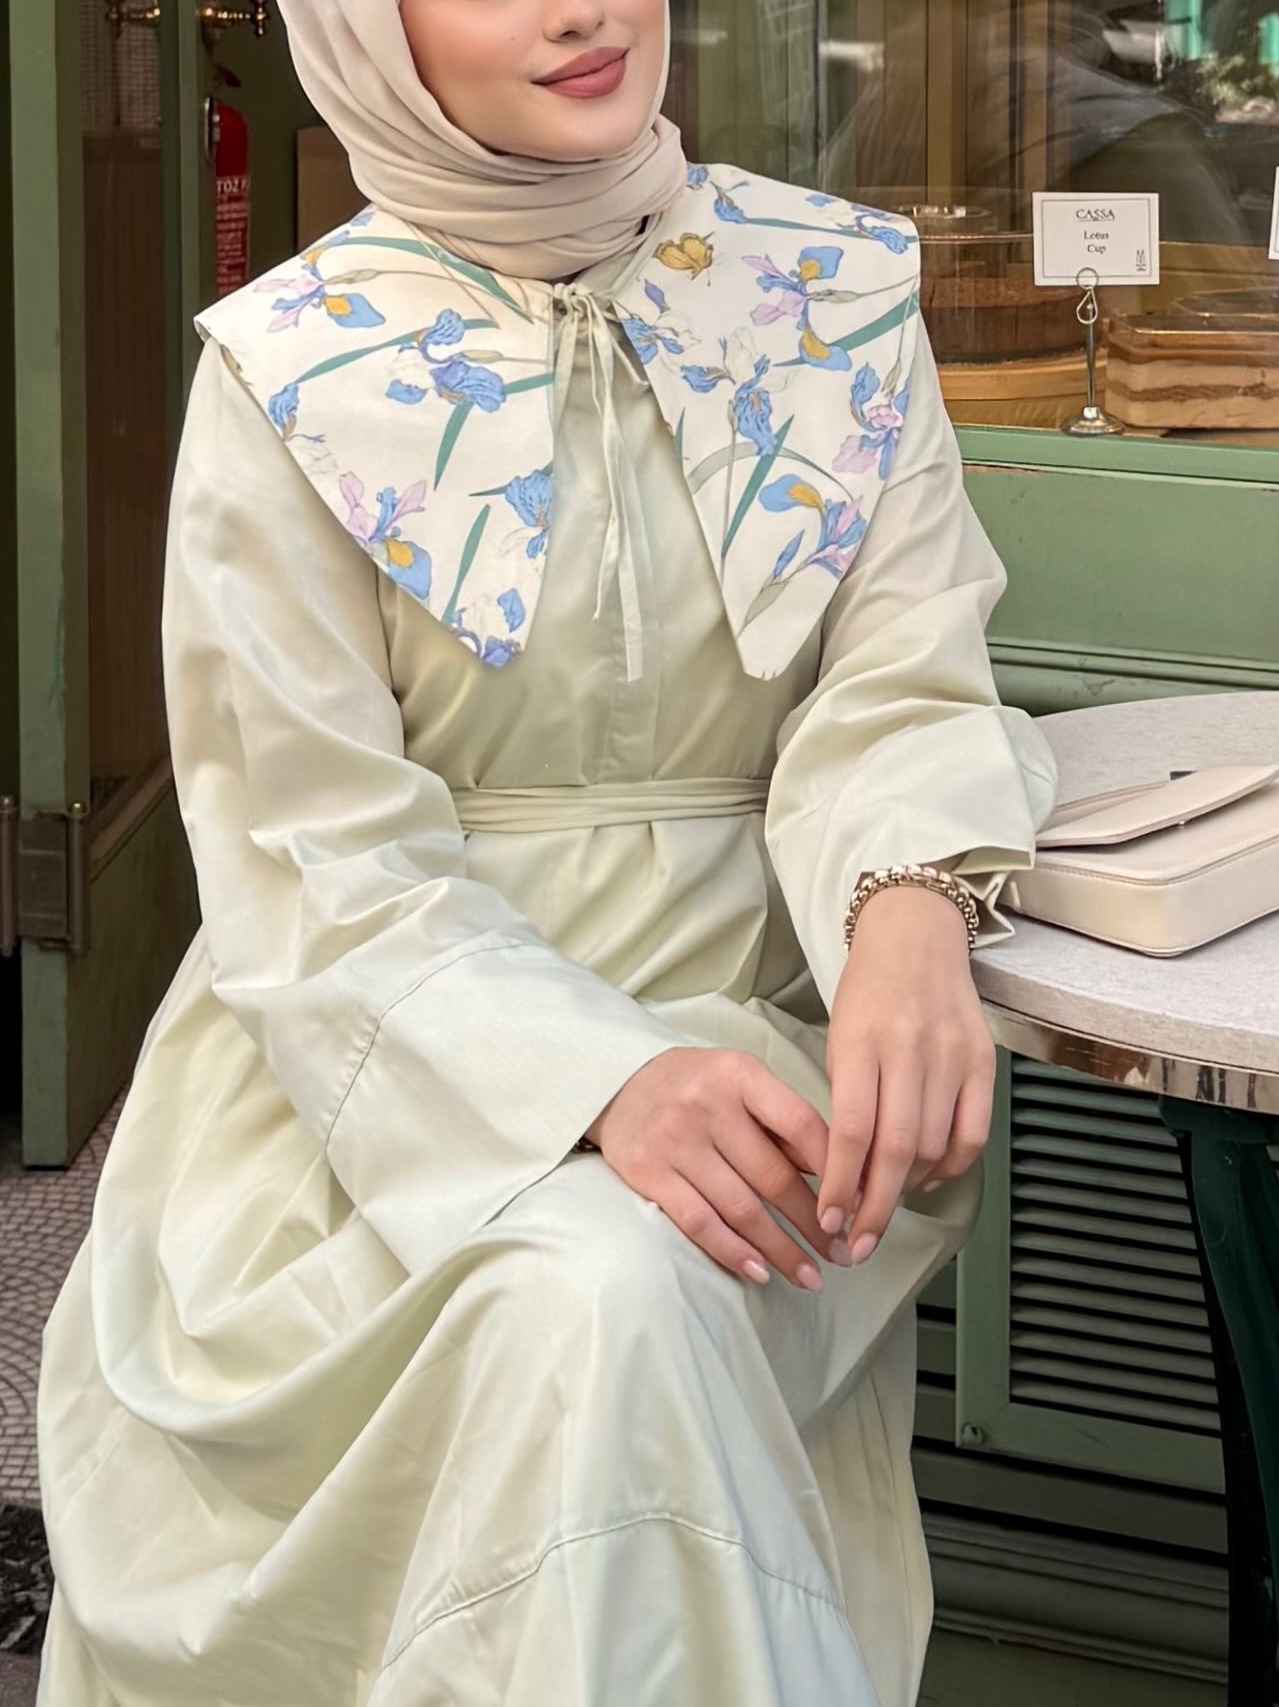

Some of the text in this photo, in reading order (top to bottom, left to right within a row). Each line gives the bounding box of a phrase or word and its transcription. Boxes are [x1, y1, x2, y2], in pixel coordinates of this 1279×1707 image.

[1076, 208, 1115, 222] CASSA
[1083, 230, 1109, 240] Lotus
[1087, 244, 1106, 254] Cup
